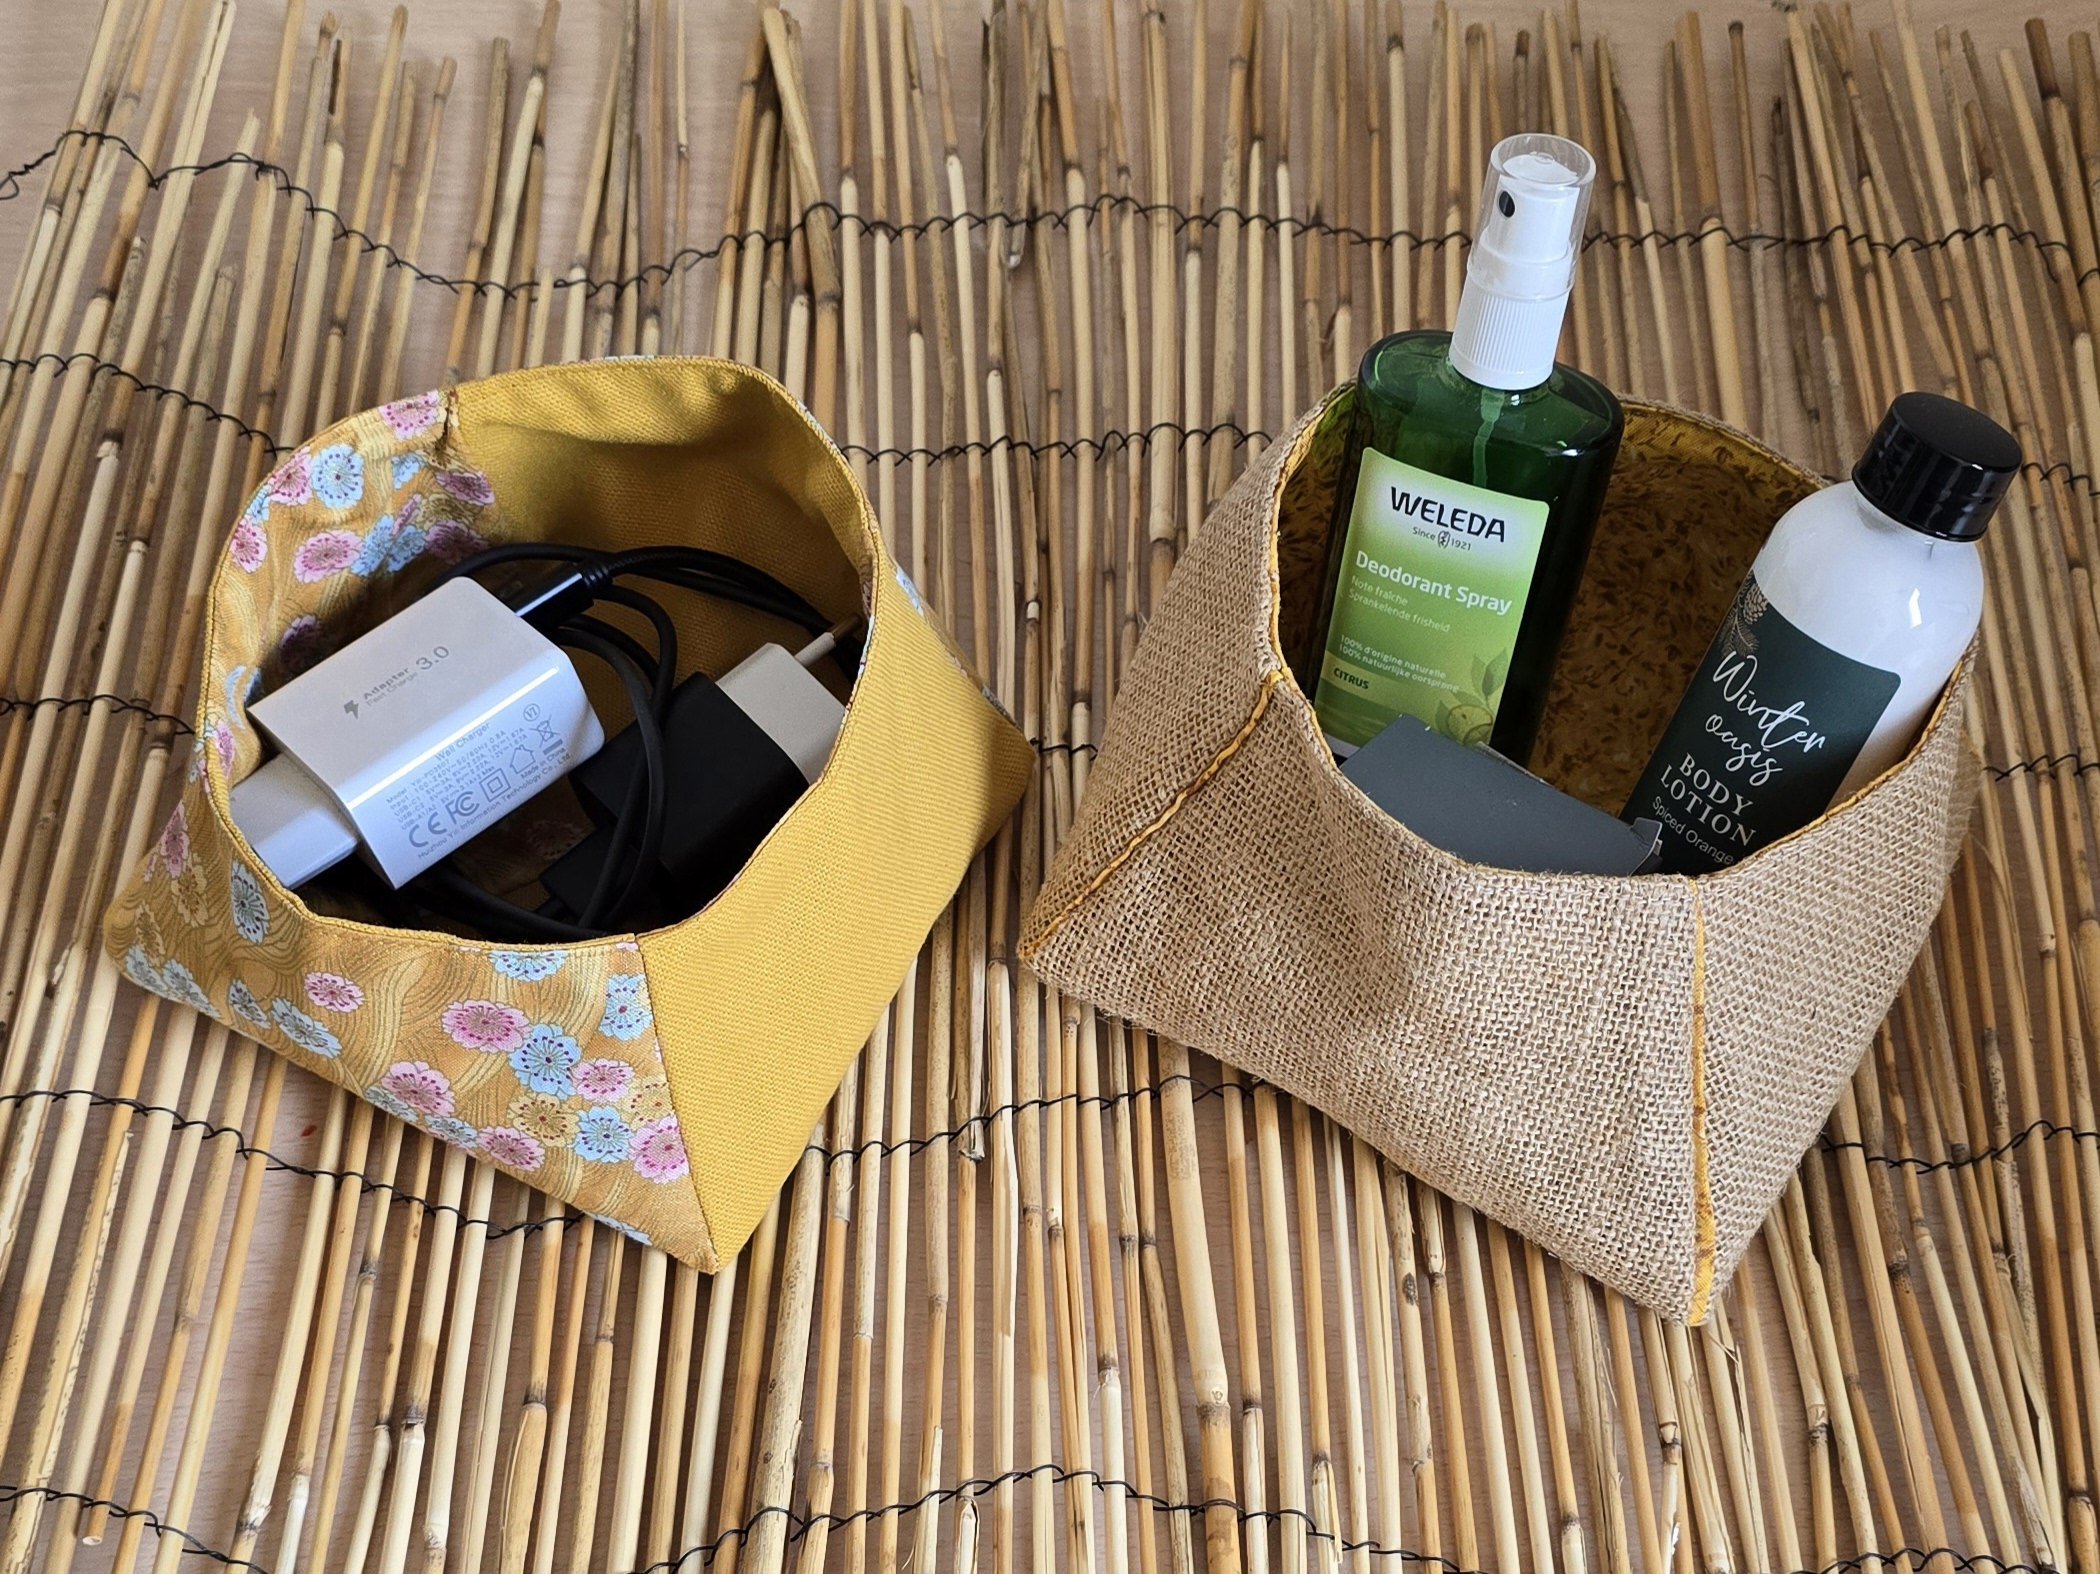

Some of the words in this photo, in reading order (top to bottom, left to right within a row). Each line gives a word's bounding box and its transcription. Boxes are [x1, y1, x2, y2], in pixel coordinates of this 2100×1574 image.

[1390, 486, 1506, 543] WELEDA
[1412, 526, 1436, 541] Since
[1450, 538, 1471, 551] 1921
[1351, 576, 1374, 595] Note
[1375, 585, 1408, 606] fraîche
[1355, 550, 1451, 600] Deodorant
[1456, 586, 1512, 616] Spray
[1348, 589, 1411, 622] Sprankelende
[1412, 612, 1450, 633] frisheid
[363, 667, 410, 700] Adapter
[415, 646, 450, 670] 3.0
[1333, 667, 1370, 690] CITRUS
[1338, 644, 1361, 662] 100%
[1362, 653, 1411, 679] natuurlijke
[1340, 634, 1363, 653] 100%
[1364, 645, 1404, 667] d'origine
[1404, 657, 1447, 678] naturelle
[1713, 650, 1827, 754] Winter
[456, 723, 490, 748] Charger
[1705, 713, 1783, 787] oasis
[520, 764, 537, 779] Made
[546, 748, 566, 762] China
[1679, 752, 1754, 816] BODY
[1660, 764, 1757, 847] LOTION
[1652, 796, 1686, 835] Spiced
[1685, 829, 1734, 865] Orange
